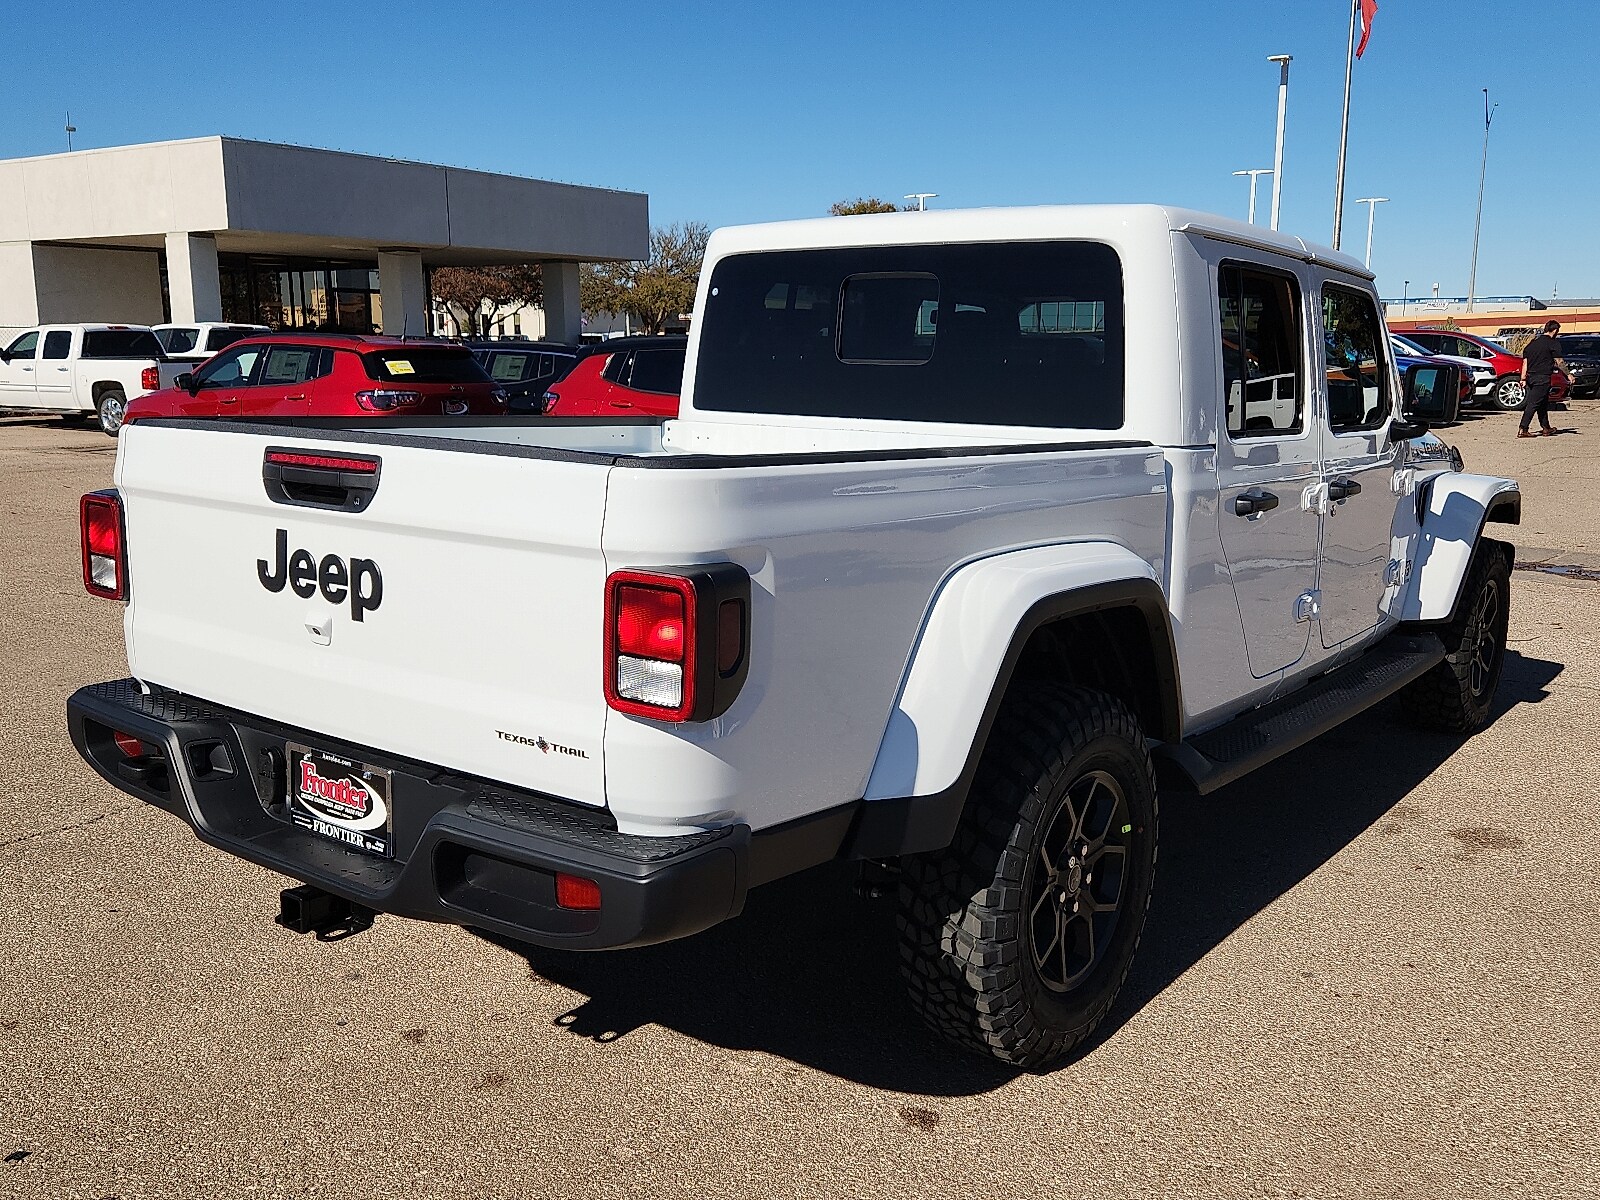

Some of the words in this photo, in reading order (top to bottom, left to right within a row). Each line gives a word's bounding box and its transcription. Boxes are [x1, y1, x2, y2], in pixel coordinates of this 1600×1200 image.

[256, 527, 384, 624] Jeep
[494, 729, 536, 747] TEXAS
[549, 742, 590, 760] TRAIL
[300, 760, 368, 812] Frontier
[313, 818, 365, 848] FRONTIER
